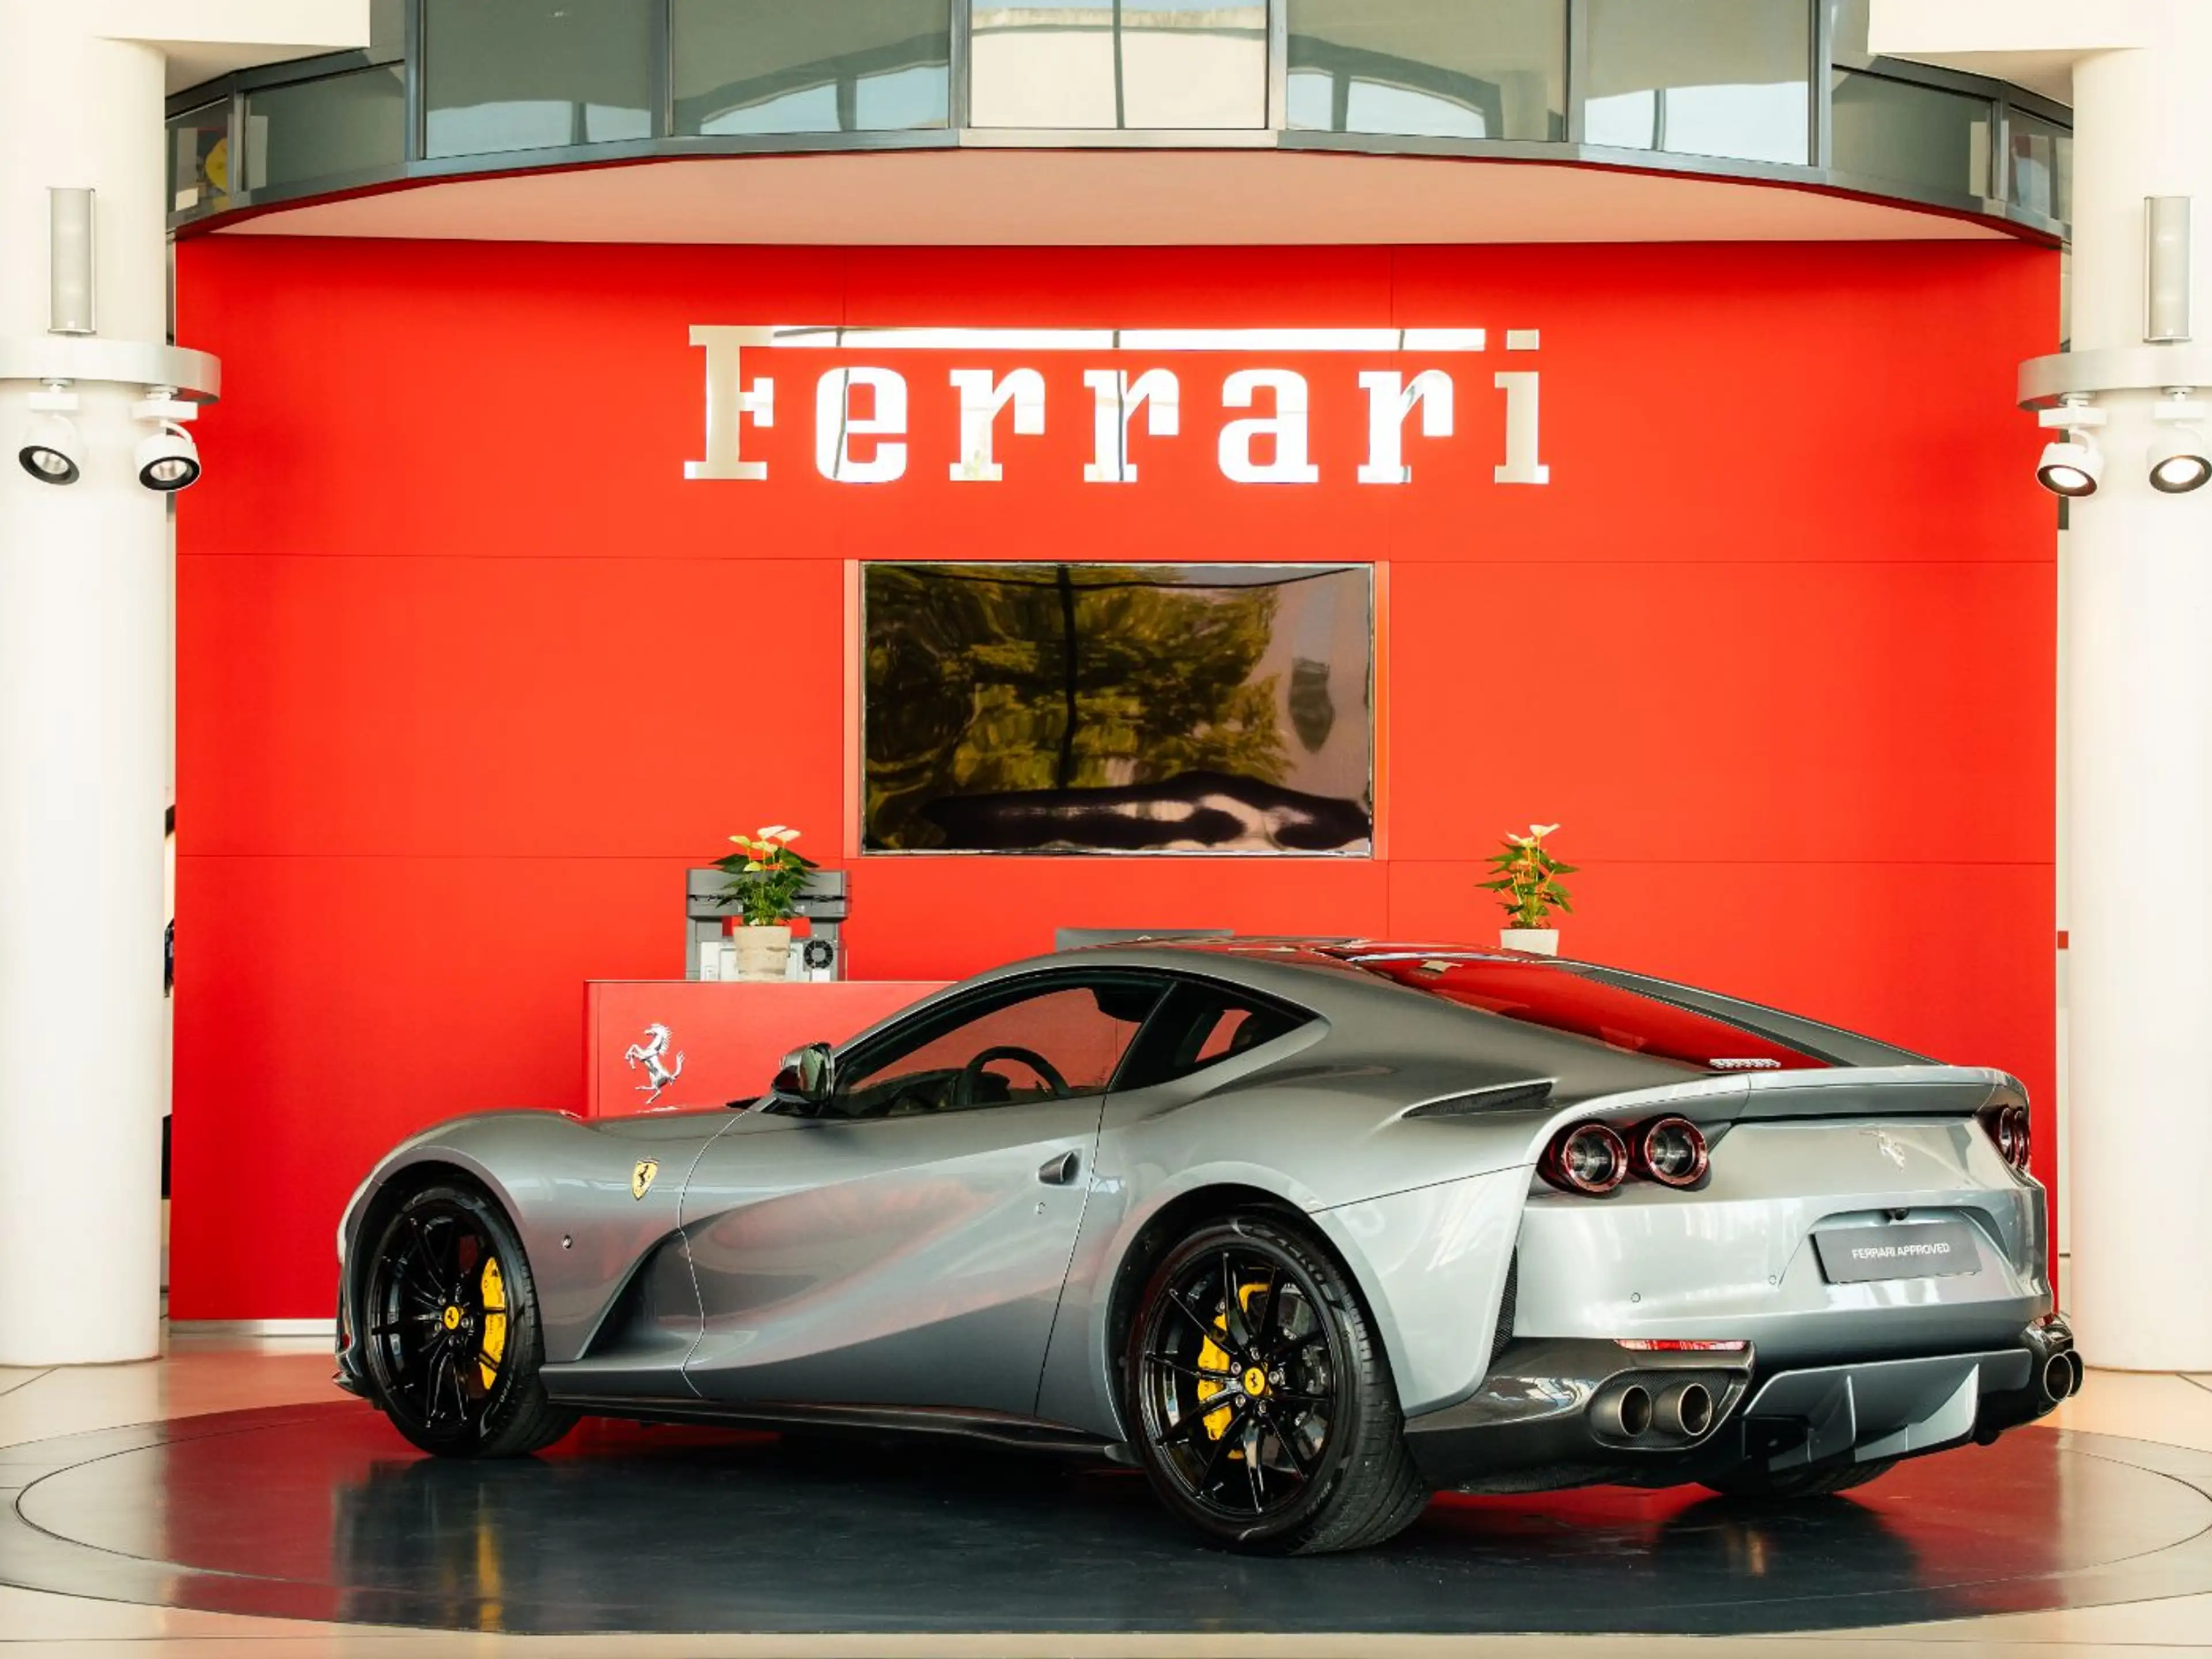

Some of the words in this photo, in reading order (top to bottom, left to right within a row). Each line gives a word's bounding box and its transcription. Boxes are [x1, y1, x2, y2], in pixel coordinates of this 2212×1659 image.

[683, 324, 1550, 484] Ferrari
[1851, 1247, 1896, 1259] FERRARI
[1897, 1243, 1950, 1256] APPROVED
